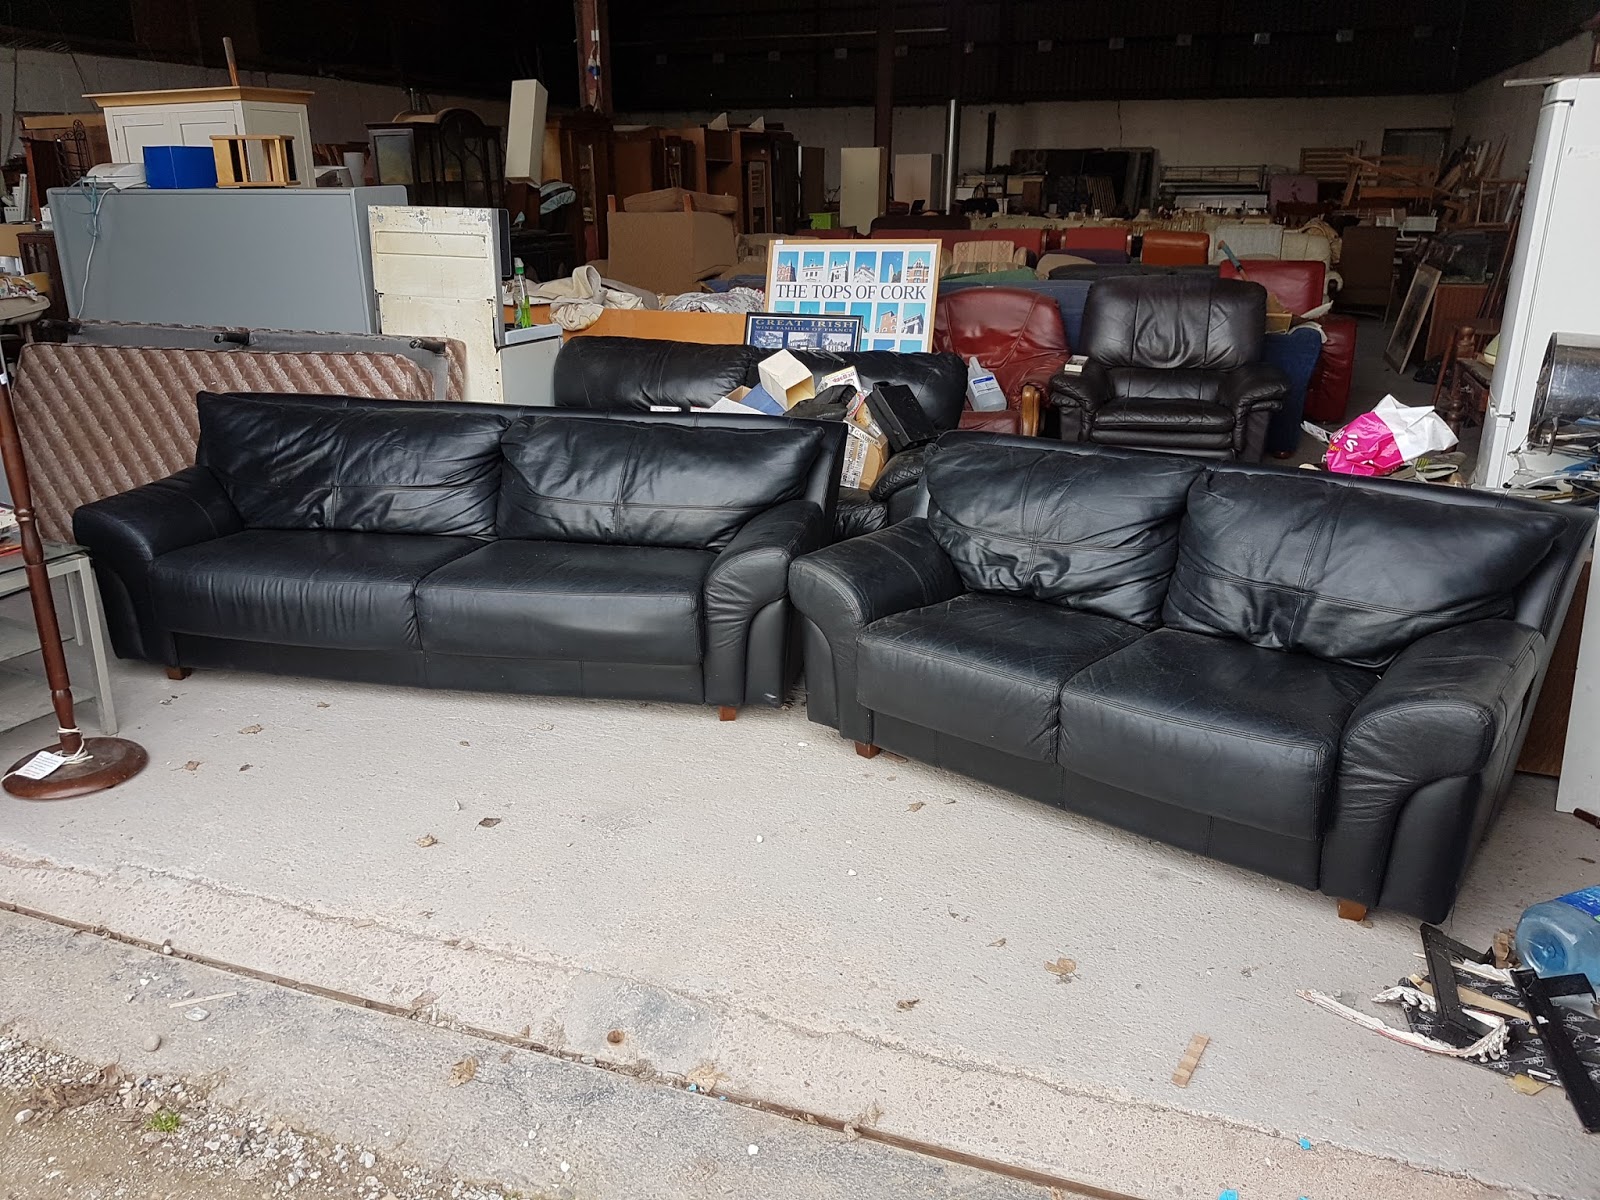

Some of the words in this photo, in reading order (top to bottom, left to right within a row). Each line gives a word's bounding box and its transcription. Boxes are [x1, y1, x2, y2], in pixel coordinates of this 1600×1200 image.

[776, 284, 807, 299] THE
[811, 284, 852, 299] TOPS
[855, 285, 877, 300] OF
[880, 285, 927, 300] CORK
